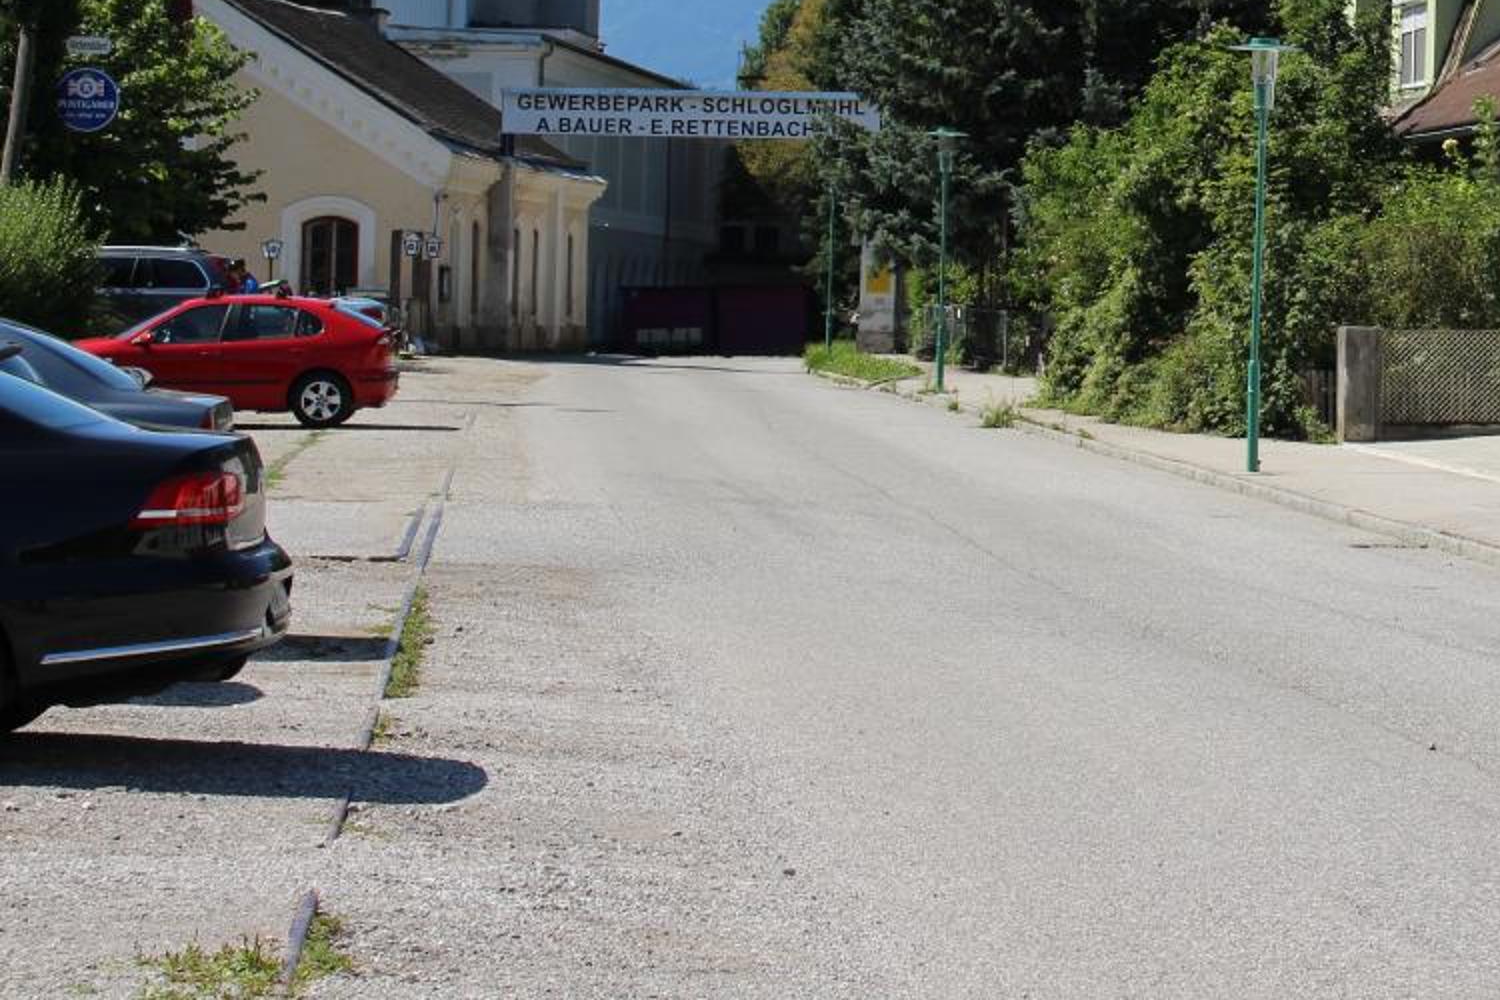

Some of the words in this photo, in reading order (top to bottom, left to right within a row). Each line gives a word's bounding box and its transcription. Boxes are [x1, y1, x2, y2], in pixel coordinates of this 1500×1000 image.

[517, 93, 685, 112] GEWERBEPARK
[535, 117, 632, 134] A.BAUER
[651, 119, 825, 137] E.RETTENBACH
